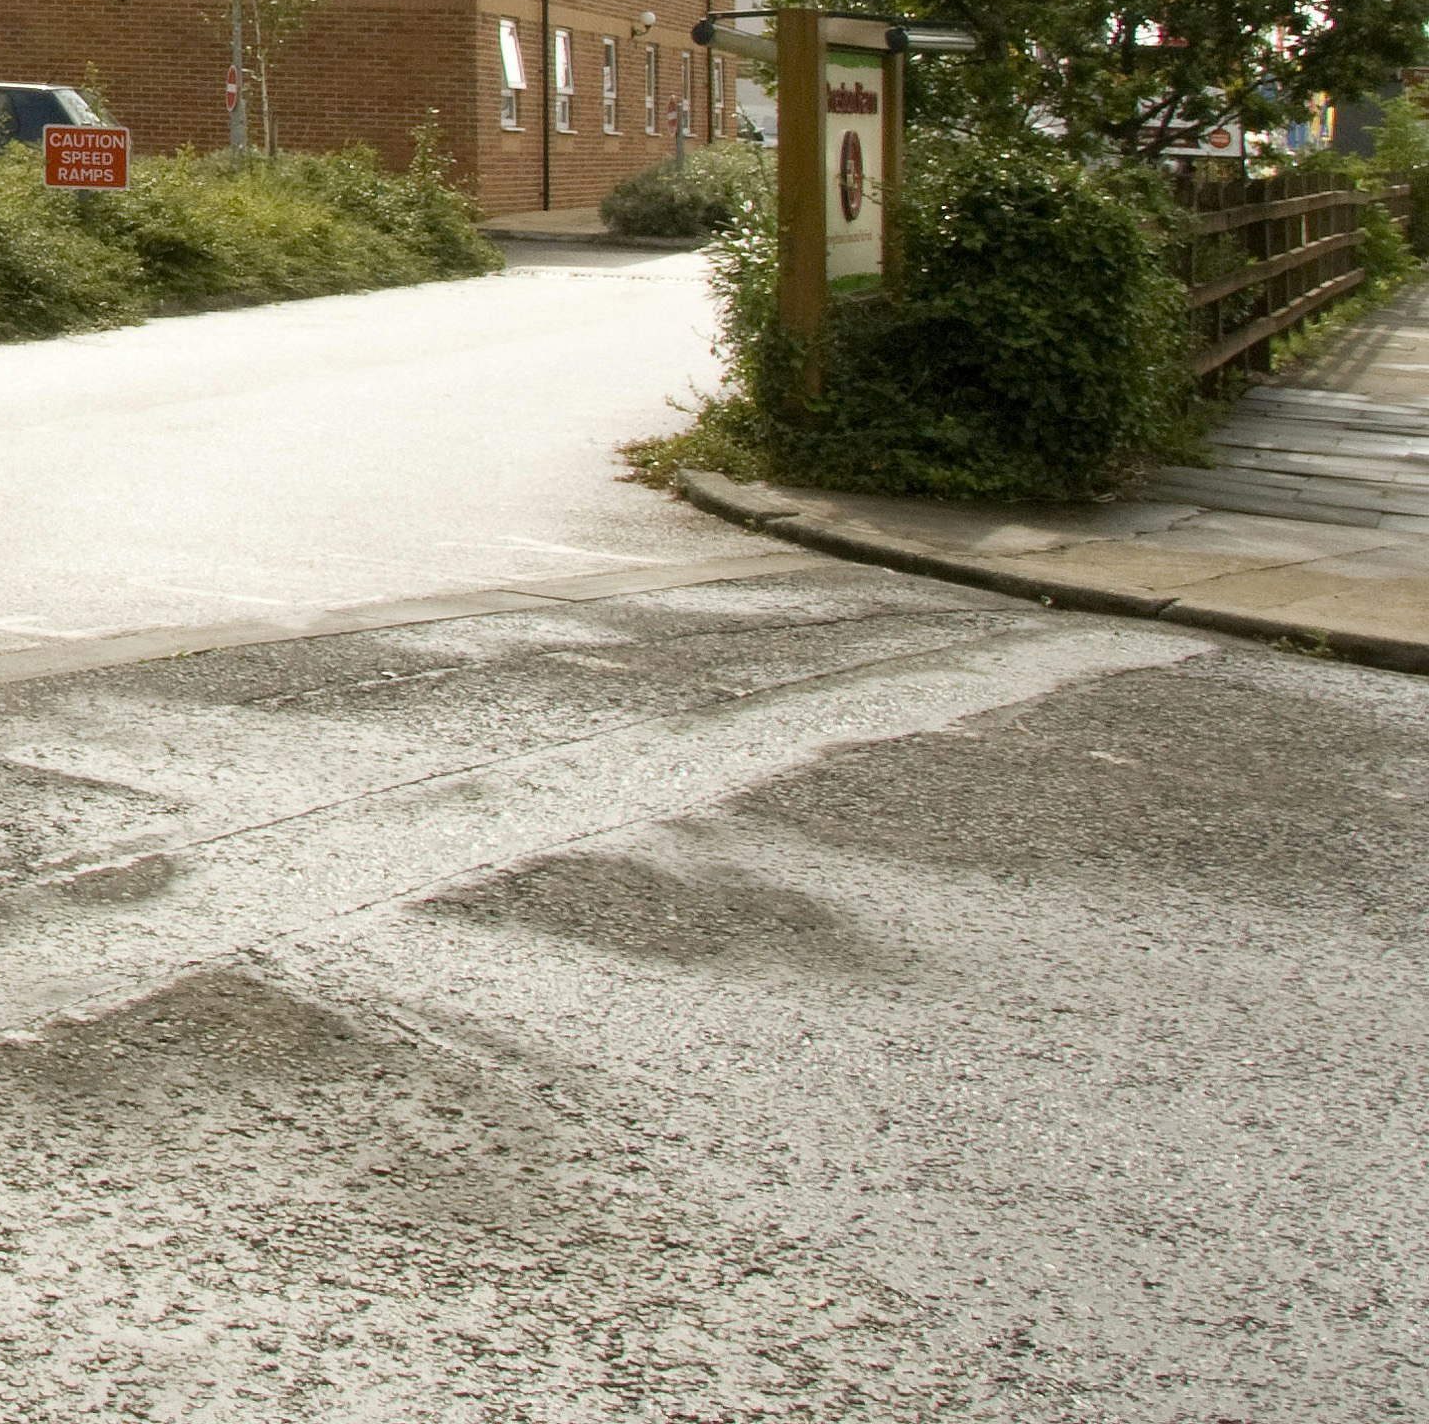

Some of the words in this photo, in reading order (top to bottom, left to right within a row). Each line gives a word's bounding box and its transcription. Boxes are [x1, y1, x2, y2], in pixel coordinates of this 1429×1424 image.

[49, 133, 125, 148] CAUTION
[61, 151, 113, 165] SPEED
[58, 167, 115, 182] RAMPS
